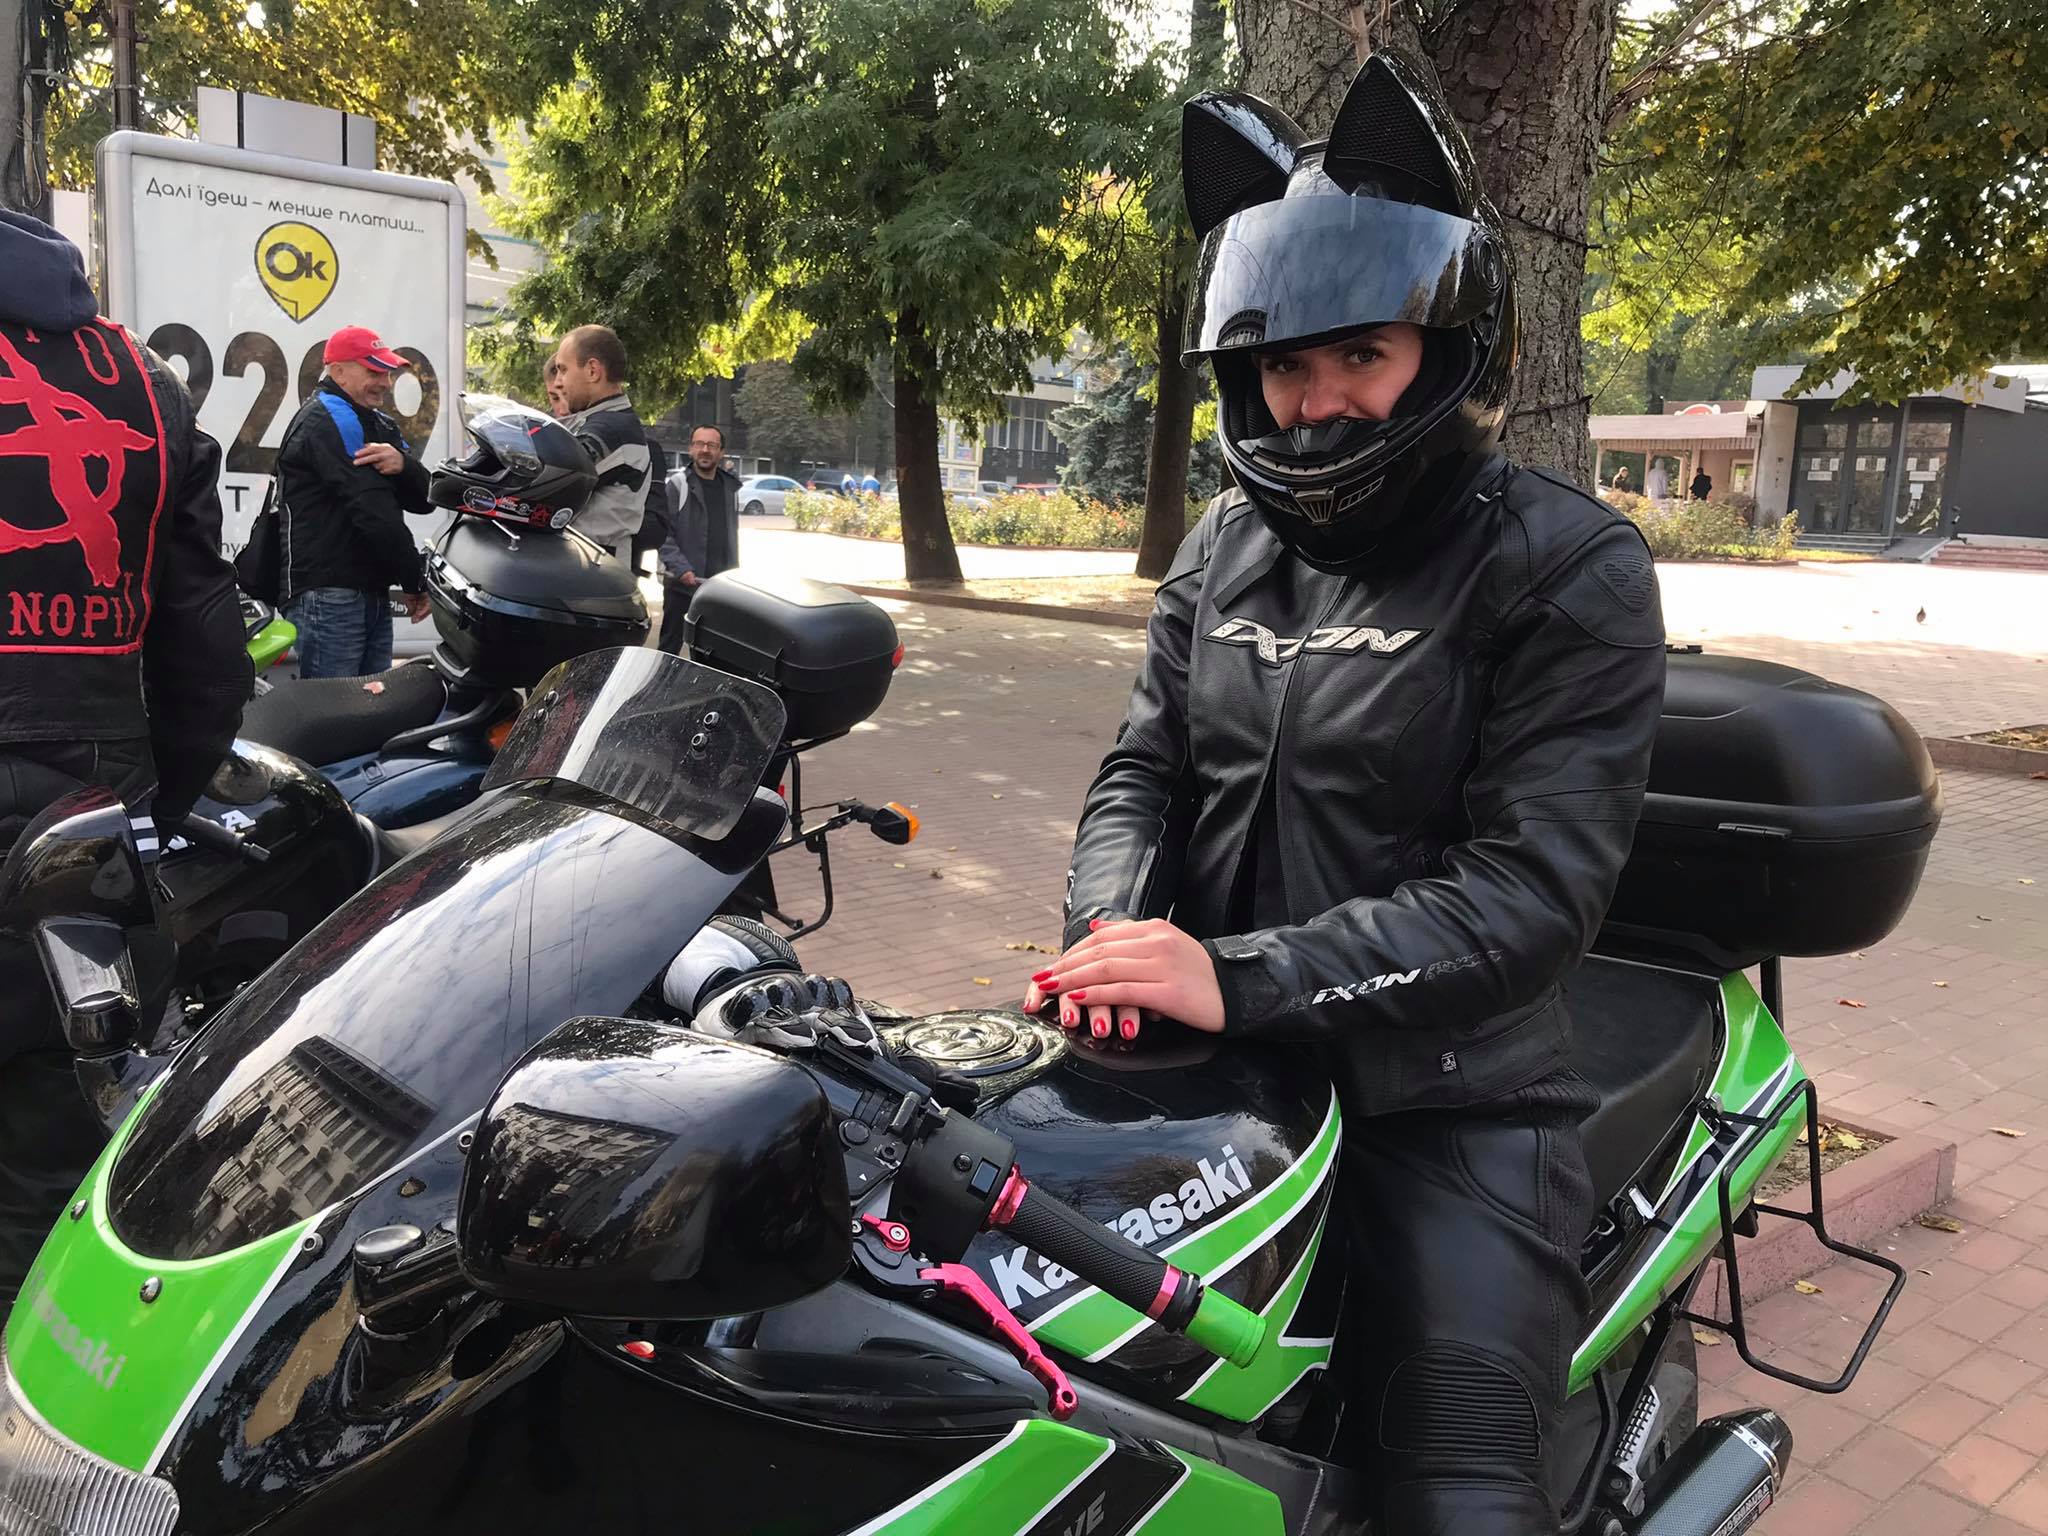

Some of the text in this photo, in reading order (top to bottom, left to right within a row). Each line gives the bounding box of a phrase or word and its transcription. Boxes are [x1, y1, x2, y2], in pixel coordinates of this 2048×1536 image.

[146, 177, 191, 199] Далі
[199, 185, 247, 206] їдеш
[268, 200, 333, 219] менше
[989, 1143, 1252, 1310] Kaasaki
[31, 1268, 127, 1391] asaki
